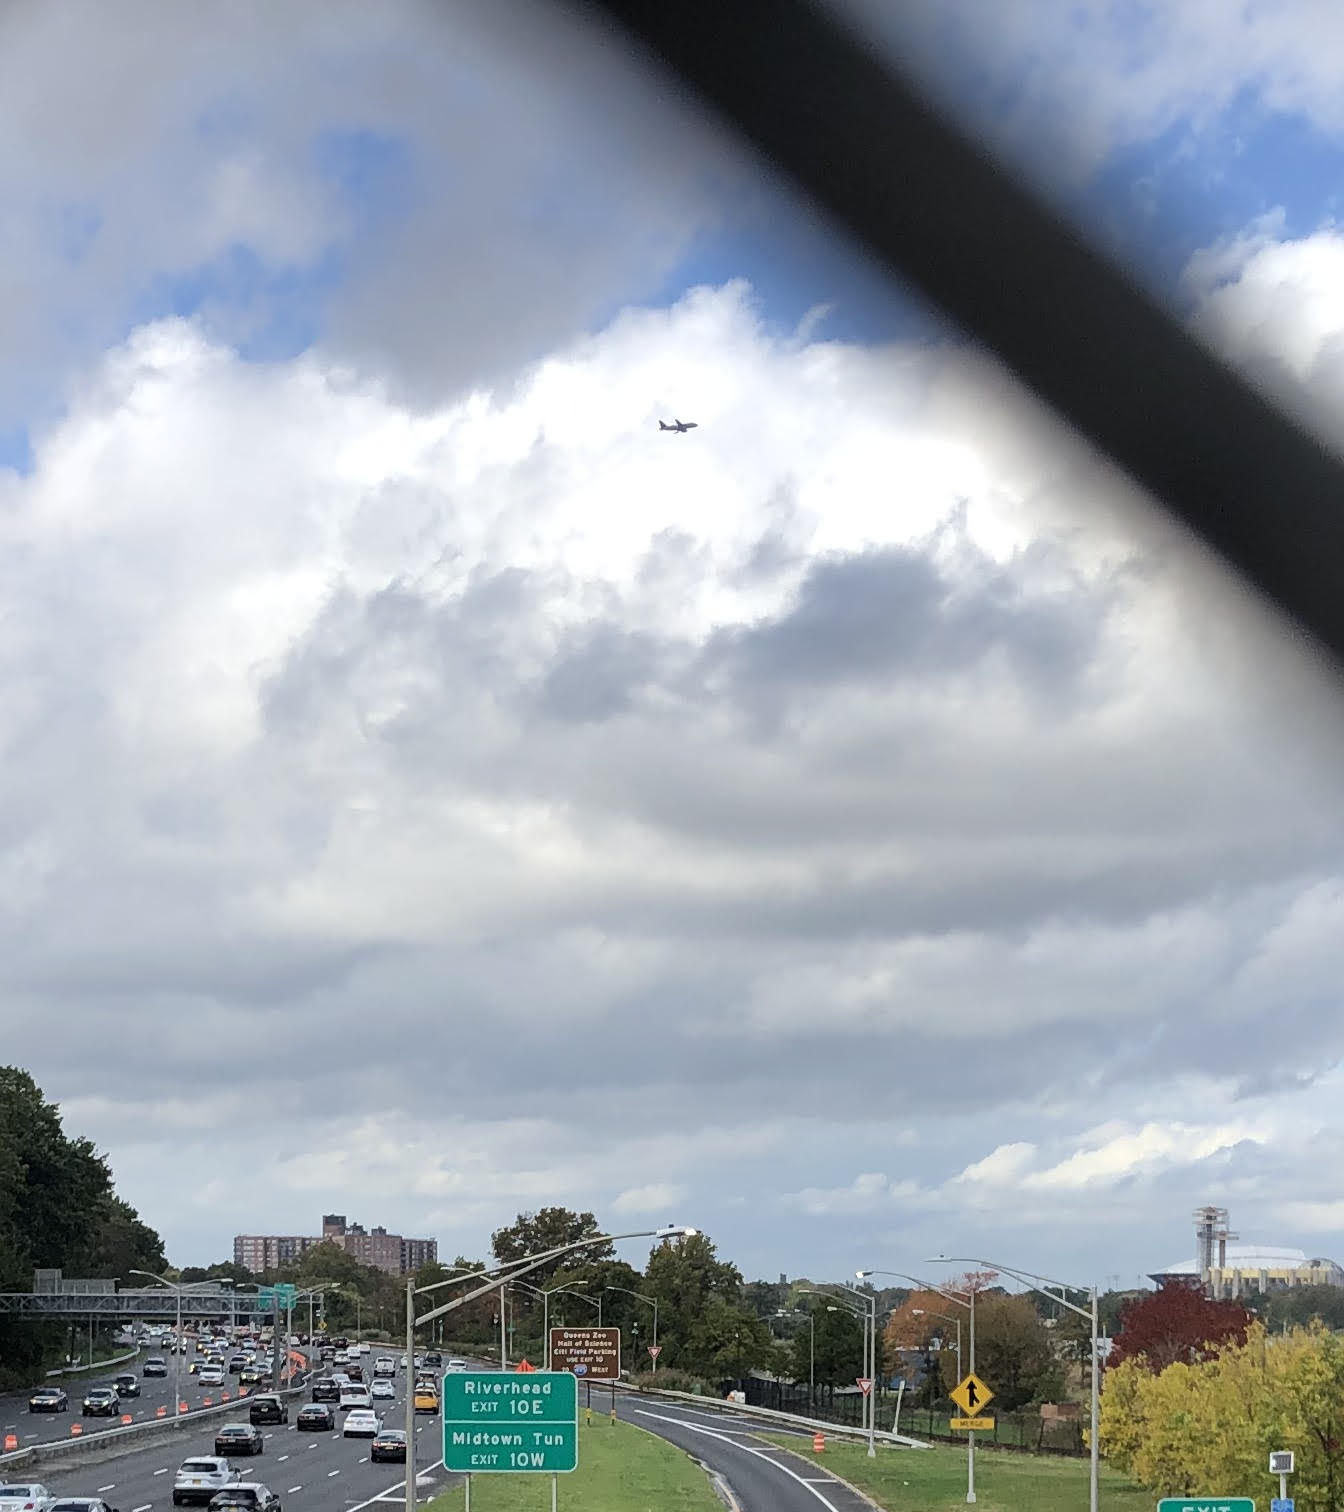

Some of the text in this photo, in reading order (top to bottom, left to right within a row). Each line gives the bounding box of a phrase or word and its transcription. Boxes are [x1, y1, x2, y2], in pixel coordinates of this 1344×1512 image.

[592, 1331, 607, 1339] Zoo
[588, 1348, 617, 1356] Parking
[464, 1381, 552, 1395] Riverhead
[471, 1400, 544, 1415] EXIT 10E
[452, 1432, 564, 1446] Midtown Tun
[471, 1452, 545, 1467] EXIT 10W
